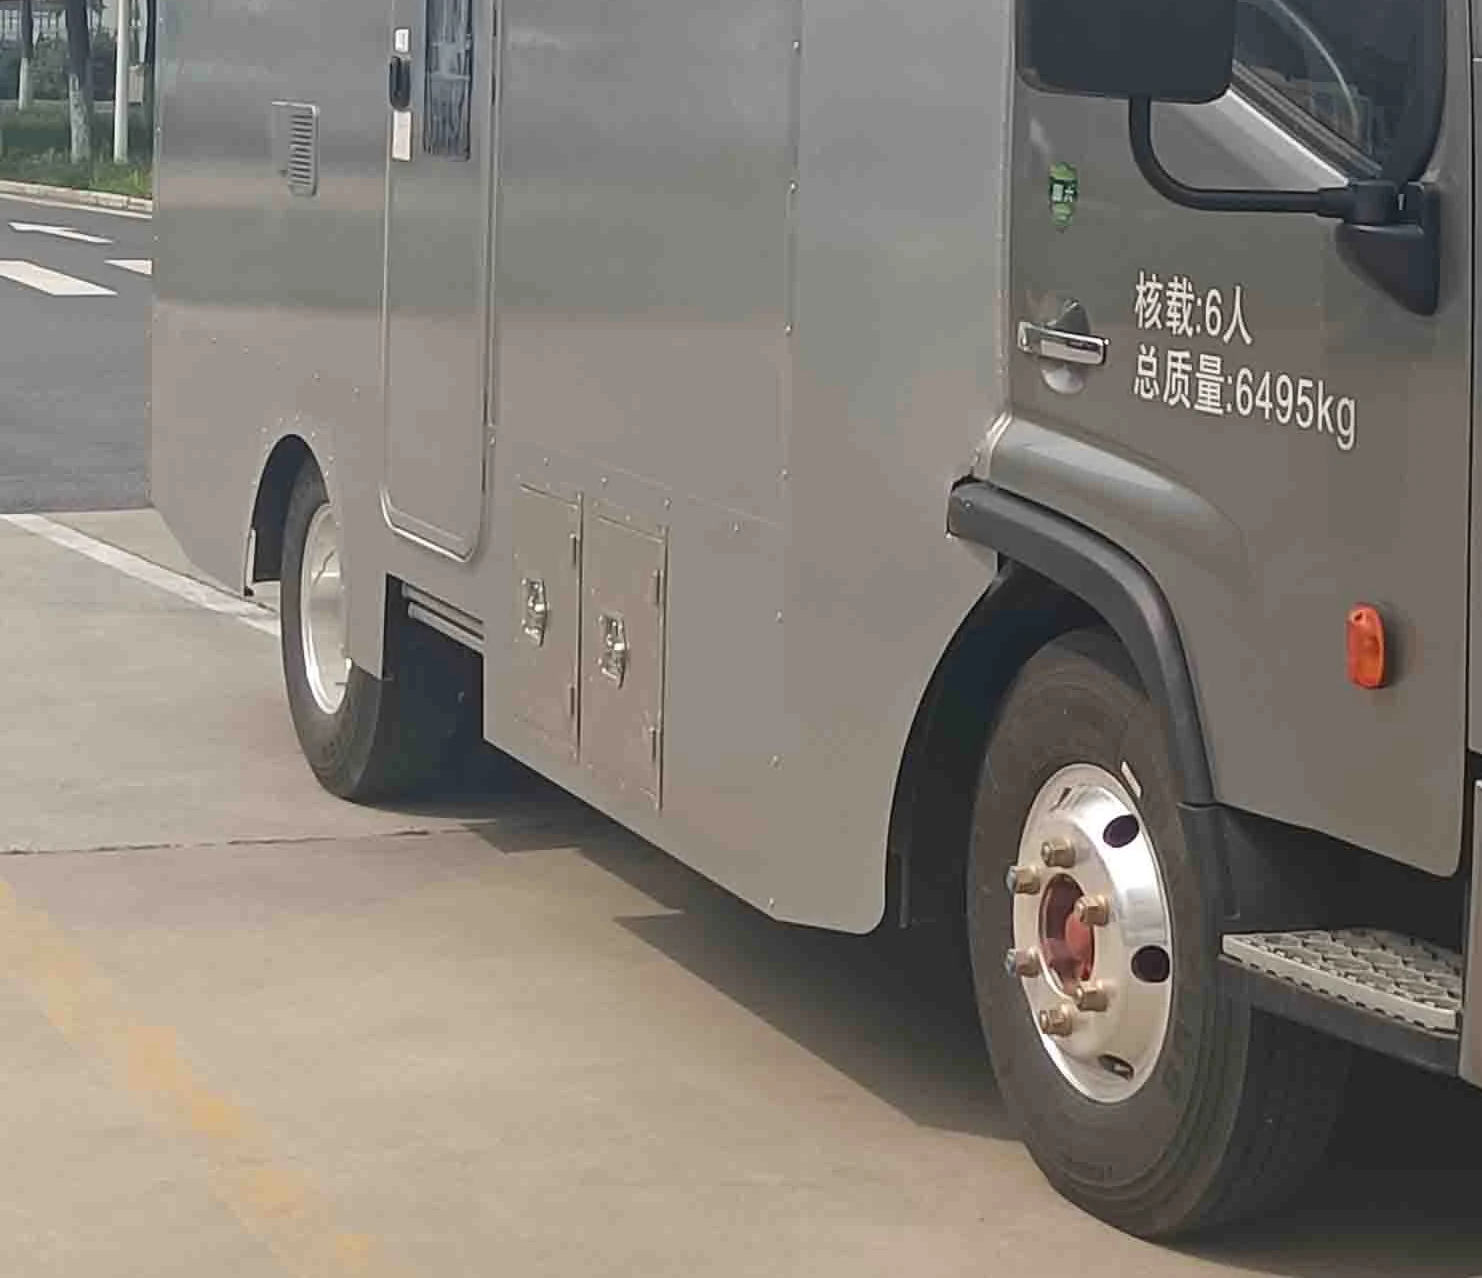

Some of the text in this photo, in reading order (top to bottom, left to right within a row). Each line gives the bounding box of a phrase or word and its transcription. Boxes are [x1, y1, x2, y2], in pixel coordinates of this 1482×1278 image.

[1134, 270, 1254, 347] 核载:6人
[1133, 343, 1358, 452] 总质量:6495kg
